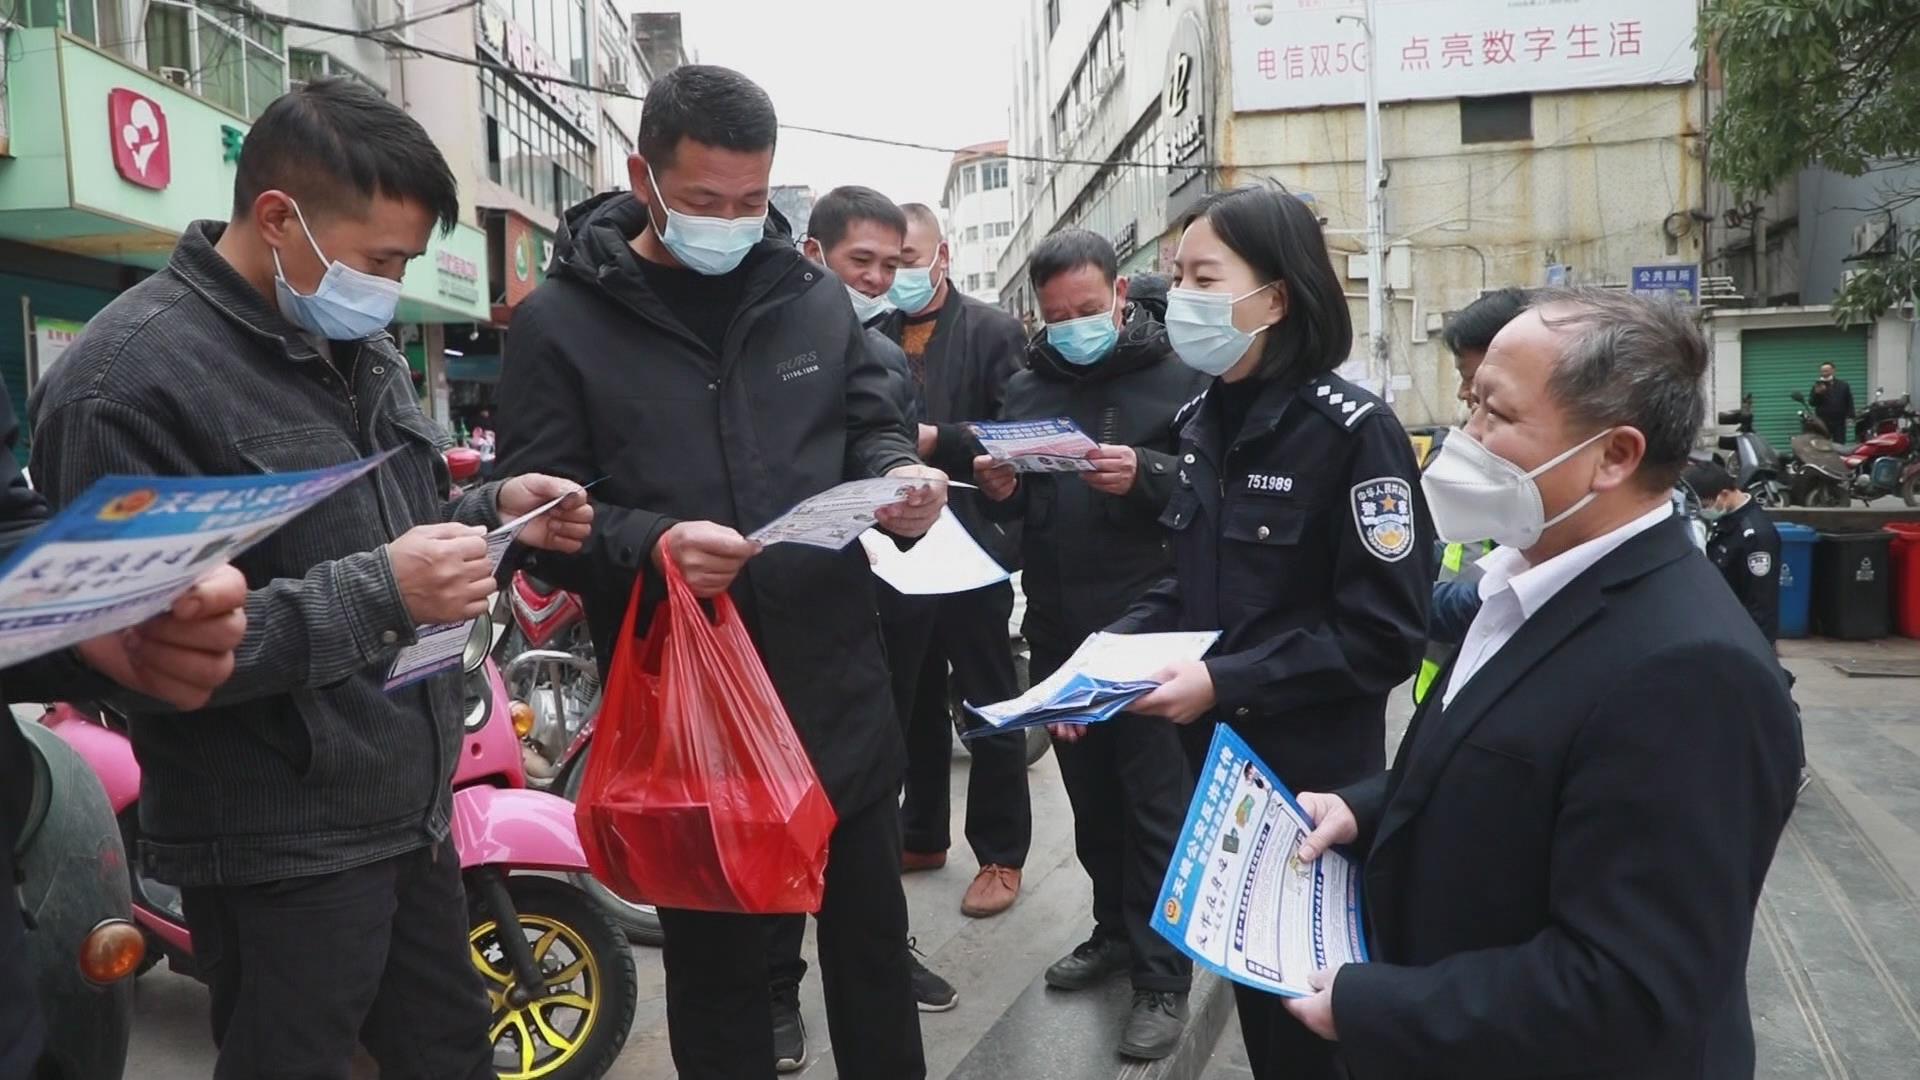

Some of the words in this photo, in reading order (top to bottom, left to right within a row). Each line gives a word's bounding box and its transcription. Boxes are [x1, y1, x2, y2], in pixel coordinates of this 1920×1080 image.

[1257, 42, 1366, 80] 电信双5G
[1399, 20, 1644, 72] 点亮数字生活
[1639, 270, 1690, 282] 公共厕所
[1247, 474, 1293, 492] 751989
